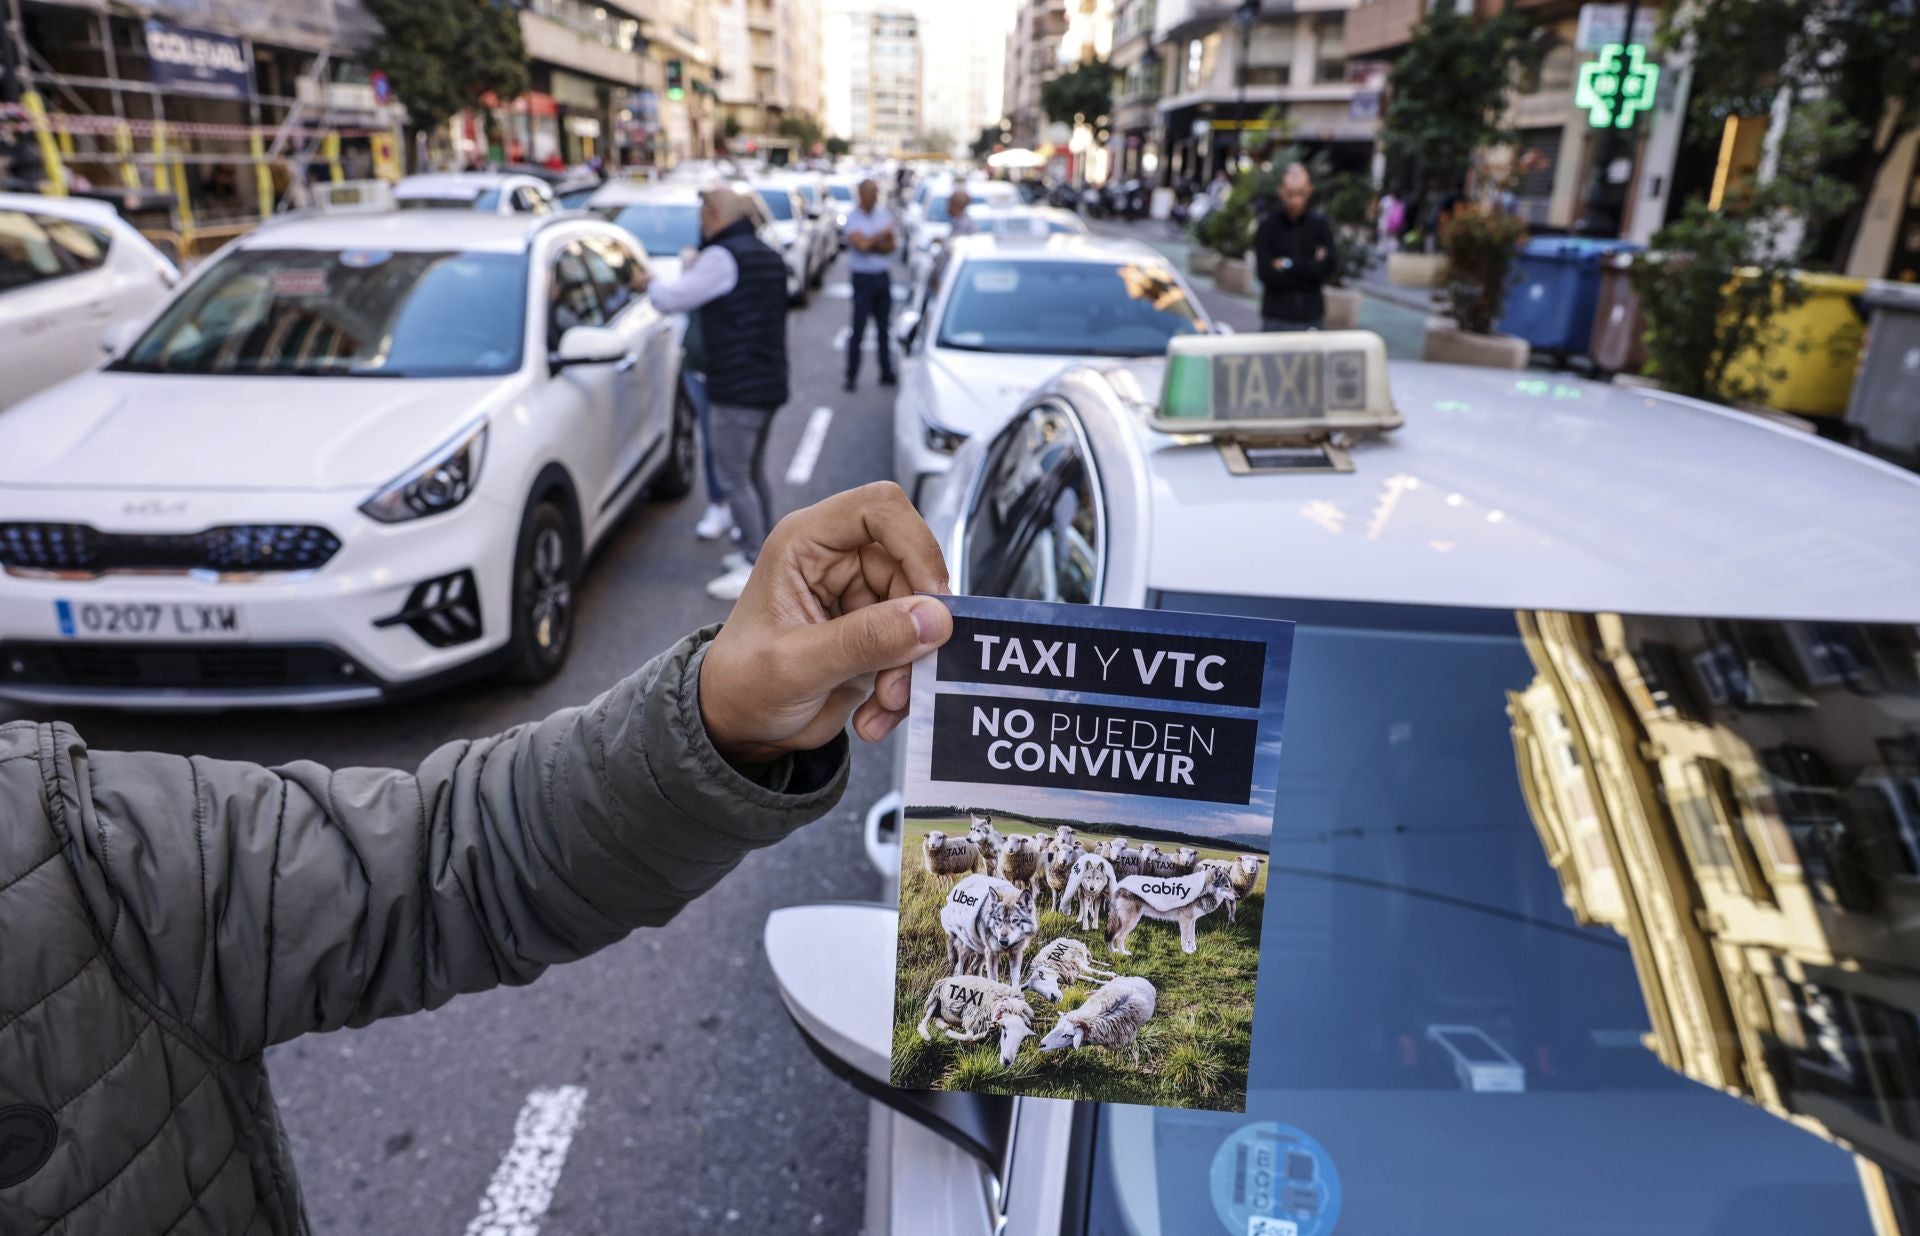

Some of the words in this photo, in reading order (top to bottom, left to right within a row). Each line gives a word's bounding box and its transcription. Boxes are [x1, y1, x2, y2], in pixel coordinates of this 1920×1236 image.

[1220, 352, 1319, 406] TAXI
[81, 603, 162, 633] 0207
[172, 603, 238, 634] LXW
[973, 633, 1077, 679] TAXI
[1093, 645, 1120, 681] Y
[1132, 648, 1227, 692] VTC
[971, 705, 1035, 739] NO
[1050, 712, 1216, 757] PUEDEN
[986, 740, 1196, 786] CONVIVIR
[946, 846, 967, 857] TAXI
[1120, 856, 1140, 867] TAXI
[1155, 860, 1175, 870] TAXI
[952, 889, 978, 907] Uber
[1141, 881, 1191, 899] cabify
[1047, 943, 1069, 962] TAXI
[950, 984, 984, 1007] TAXI
